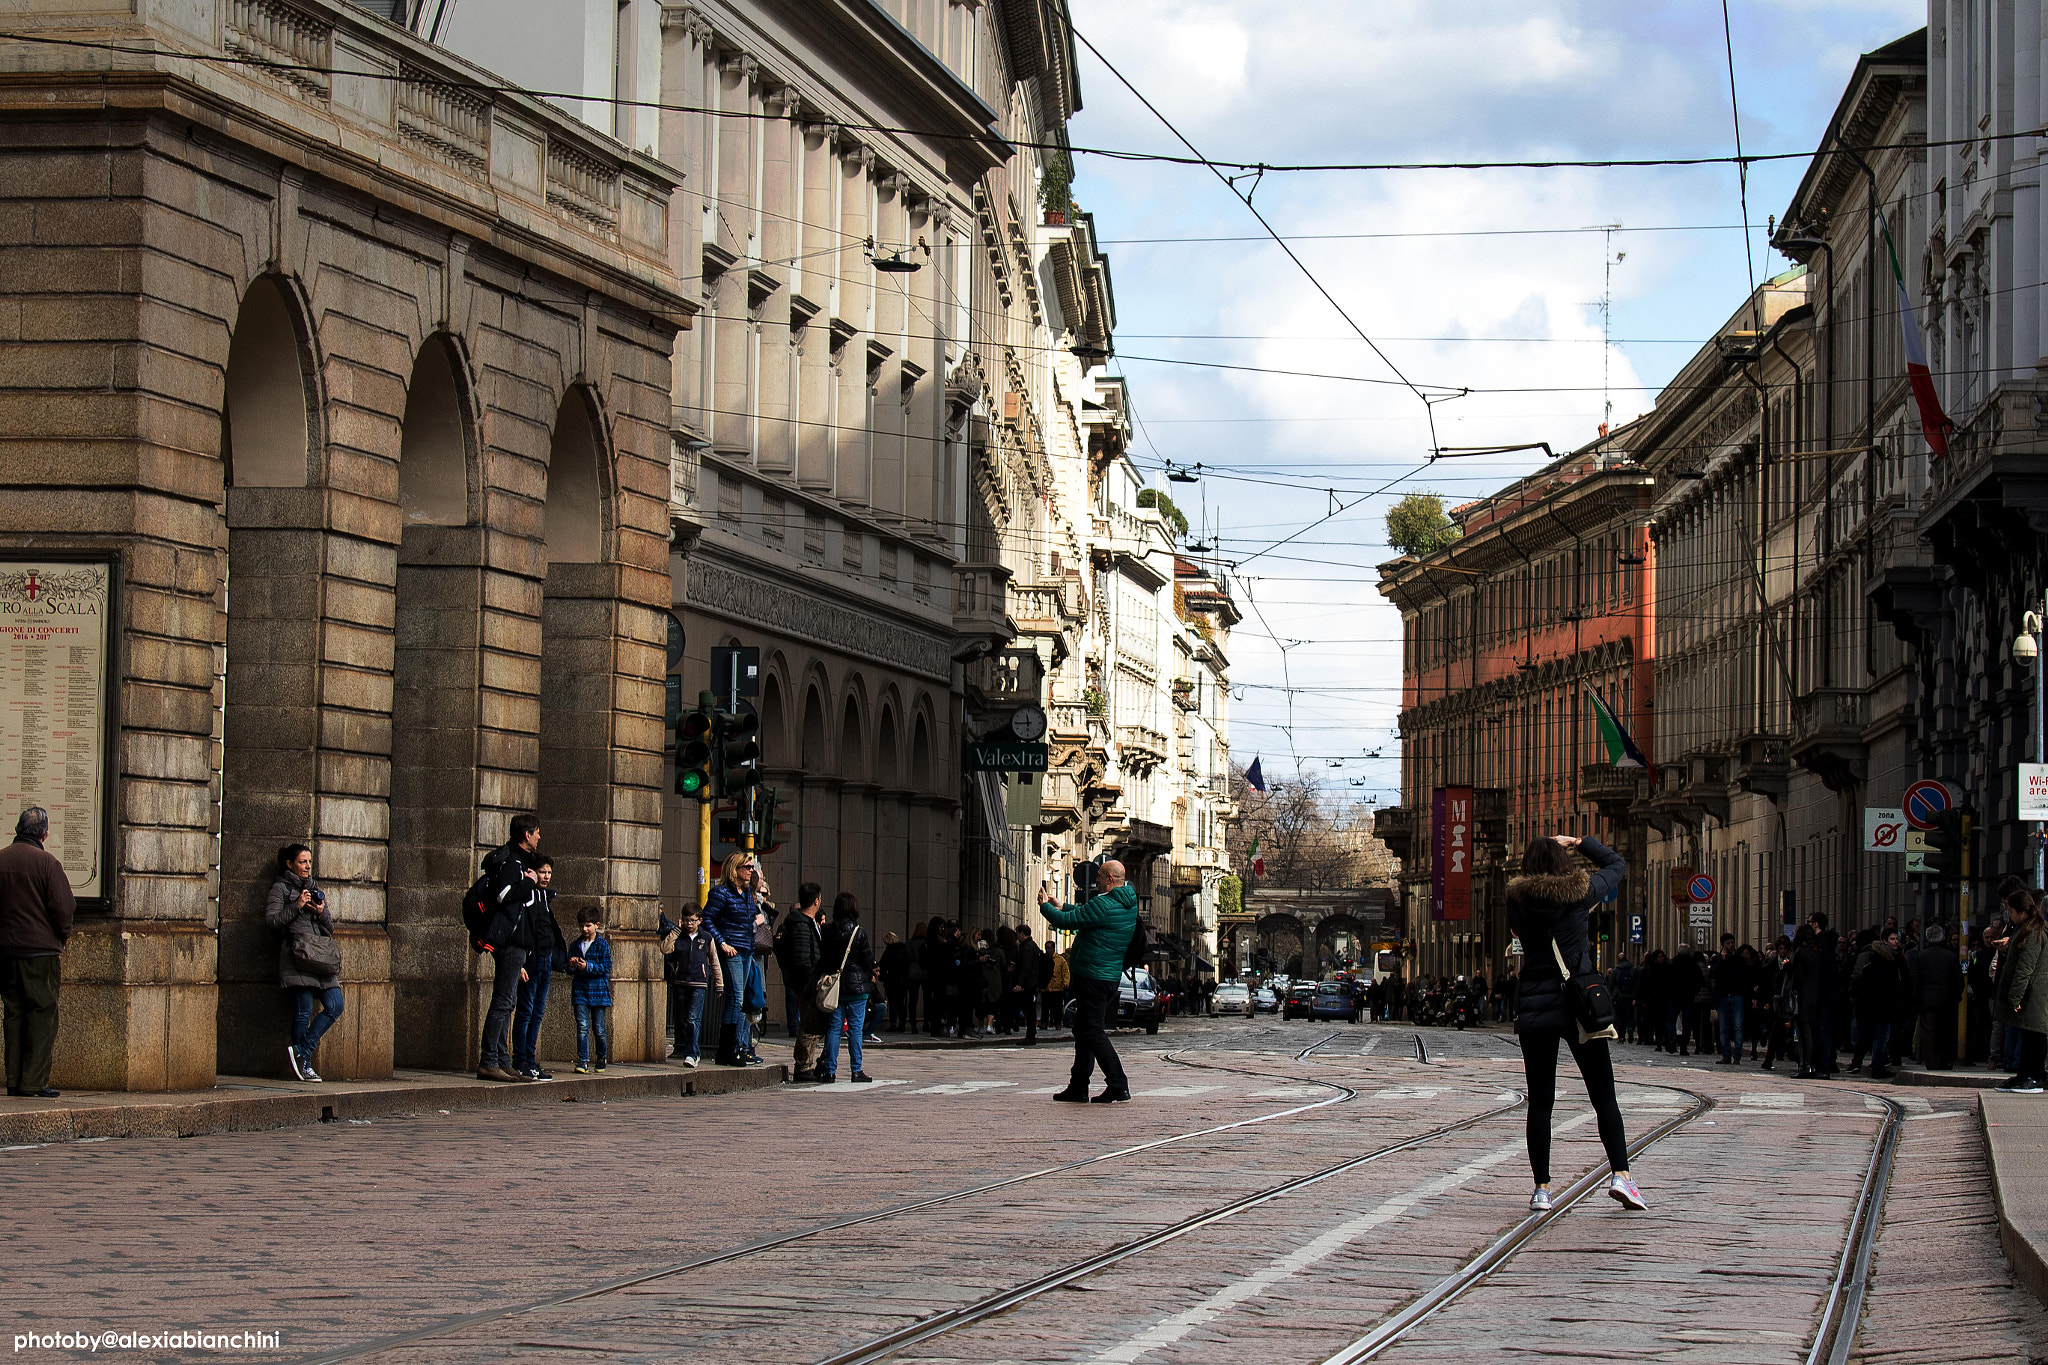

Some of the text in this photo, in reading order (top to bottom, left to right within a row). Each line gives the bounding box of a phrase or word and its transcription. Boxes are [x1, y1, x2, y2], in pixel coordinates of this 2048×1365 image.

[23, 607, 44, 615] ALLA
[46, 597, 97, 615] SCALA
[976, 747, 1044, 766] Valextra
[1451, 800, 1467, 822] M
[1632, 916, 1641, 931] P
